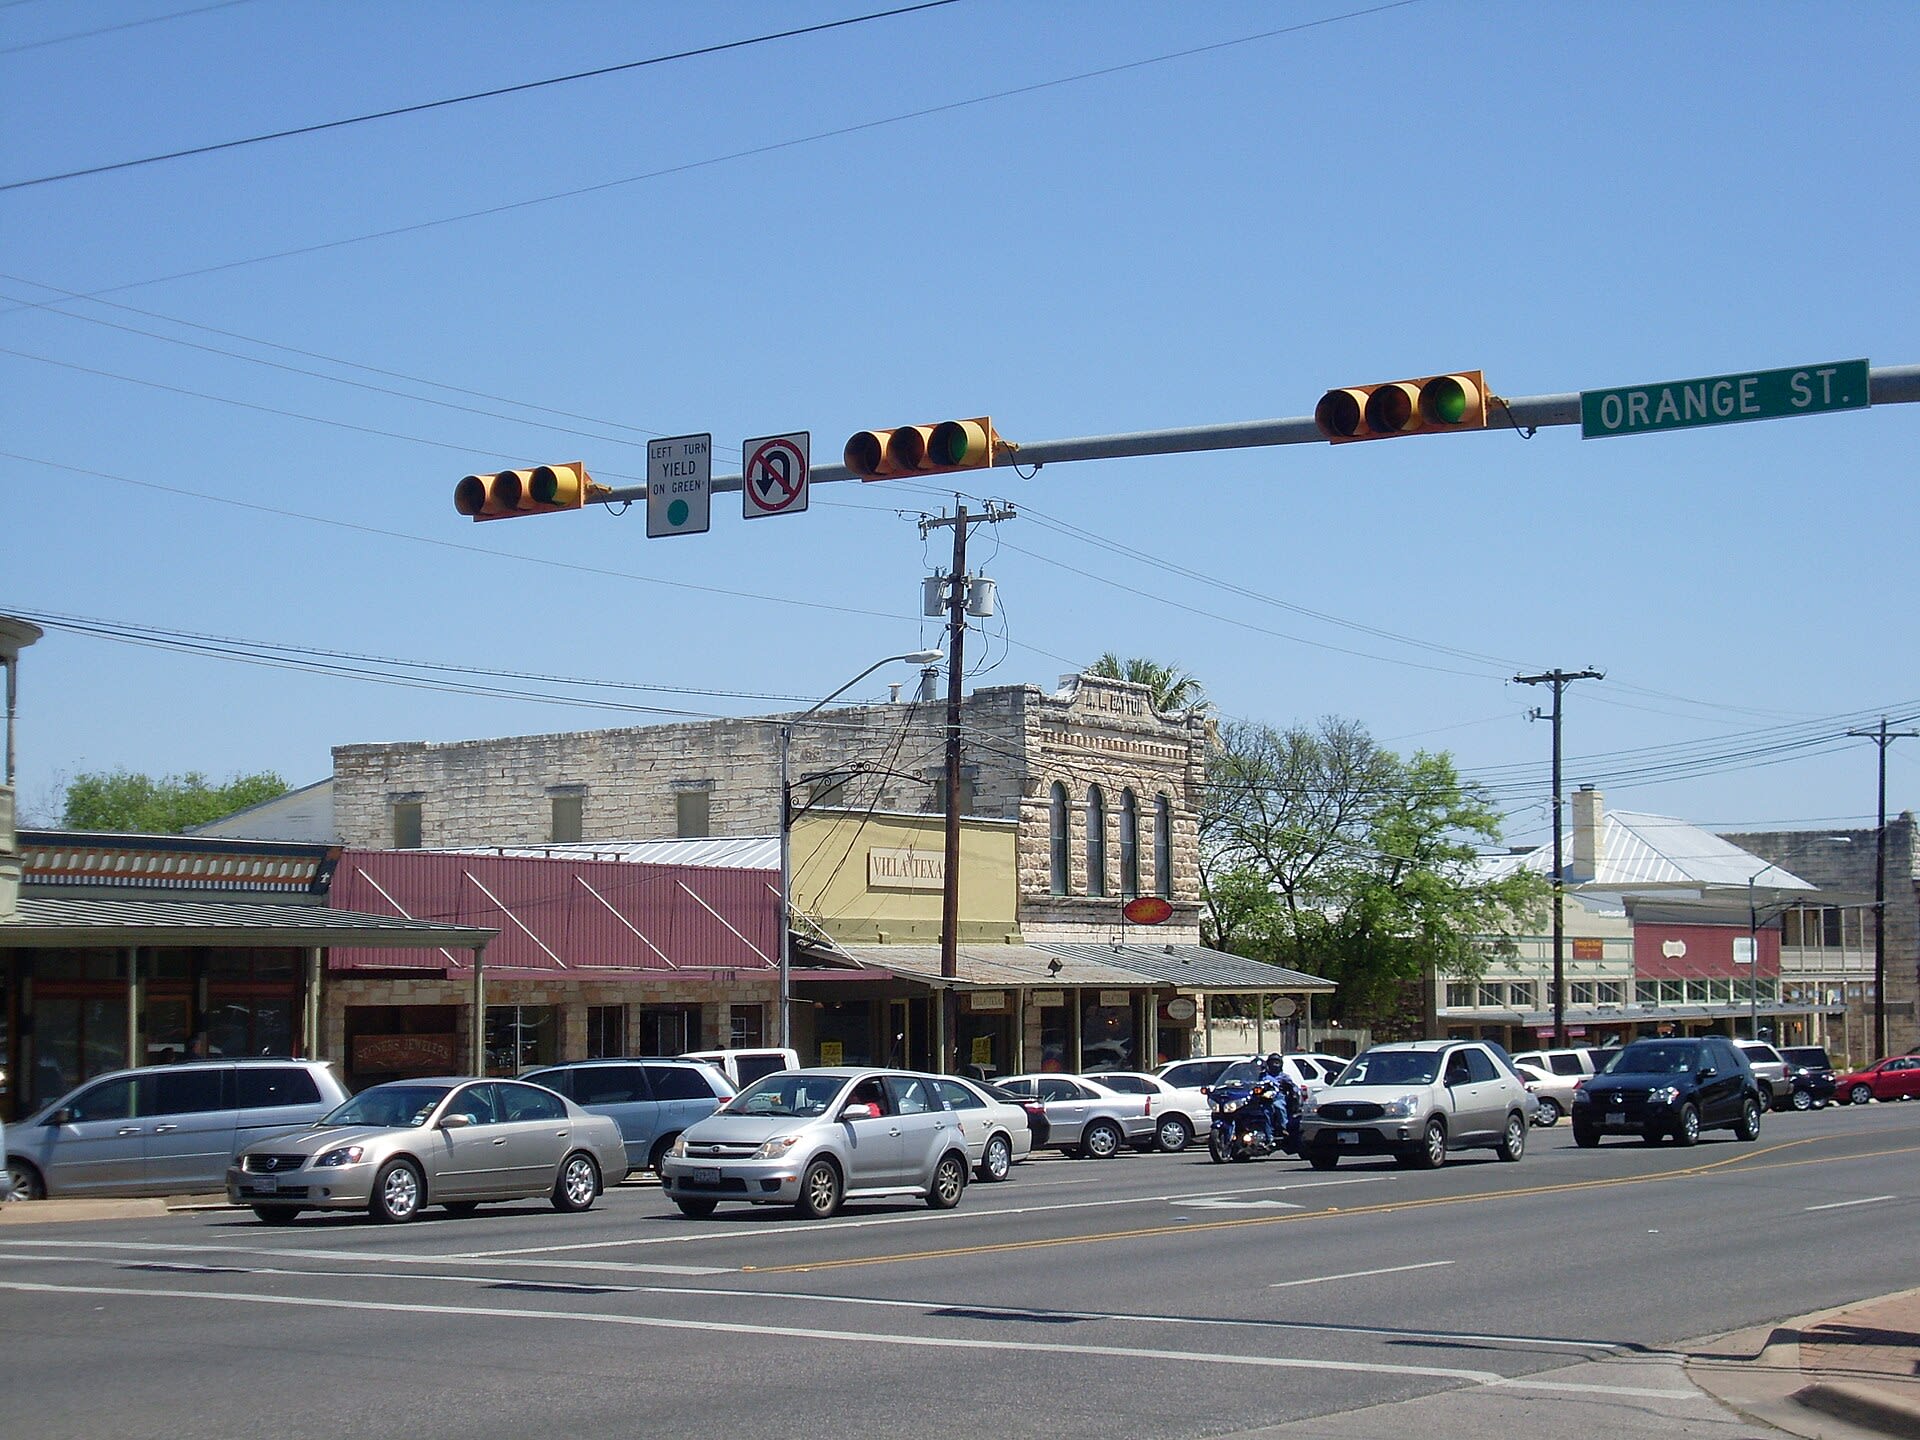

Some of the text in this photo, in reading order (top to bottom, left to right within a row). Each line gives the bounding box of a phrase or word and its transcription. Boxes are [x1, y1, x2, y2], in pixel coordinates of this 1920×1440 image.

[1601, 368, 1849, 430] ORANGE ST.
[651, 442, 707, 460] LEFT TURN
[662, 460, 696, 478] YIELD
[653, 480, 701, 496] ON GREEN
[873, 856, 943, 879] VILLA TEXA
